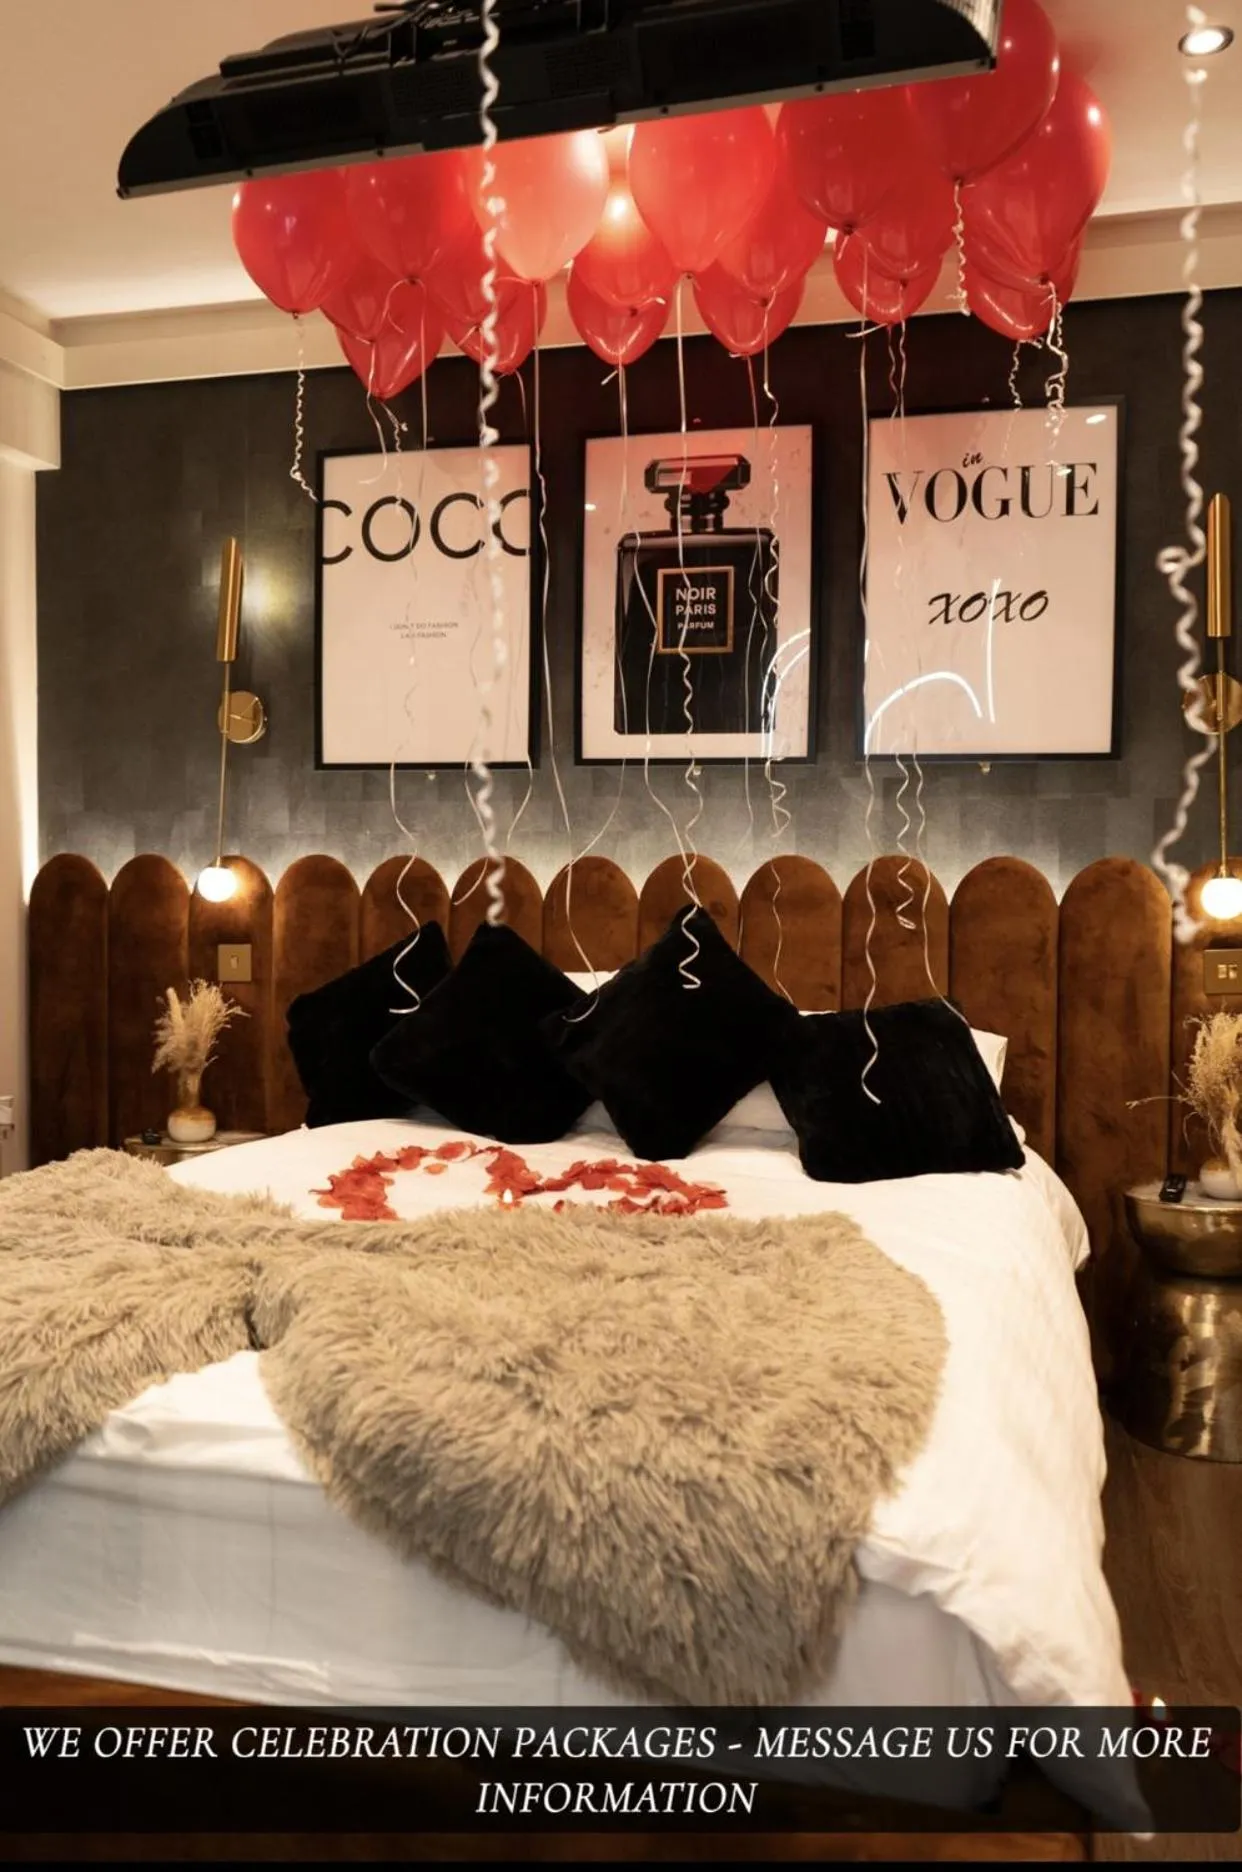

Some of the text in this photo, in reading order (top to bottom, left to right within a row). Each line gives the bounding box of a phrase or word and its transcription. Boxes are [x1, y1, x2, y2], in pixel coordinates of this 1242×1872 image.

[882, 462, 1099, 525] VOGUE
[675, 586, 717, 601] NOIR
[675, 603, 717, 616] PARIS
